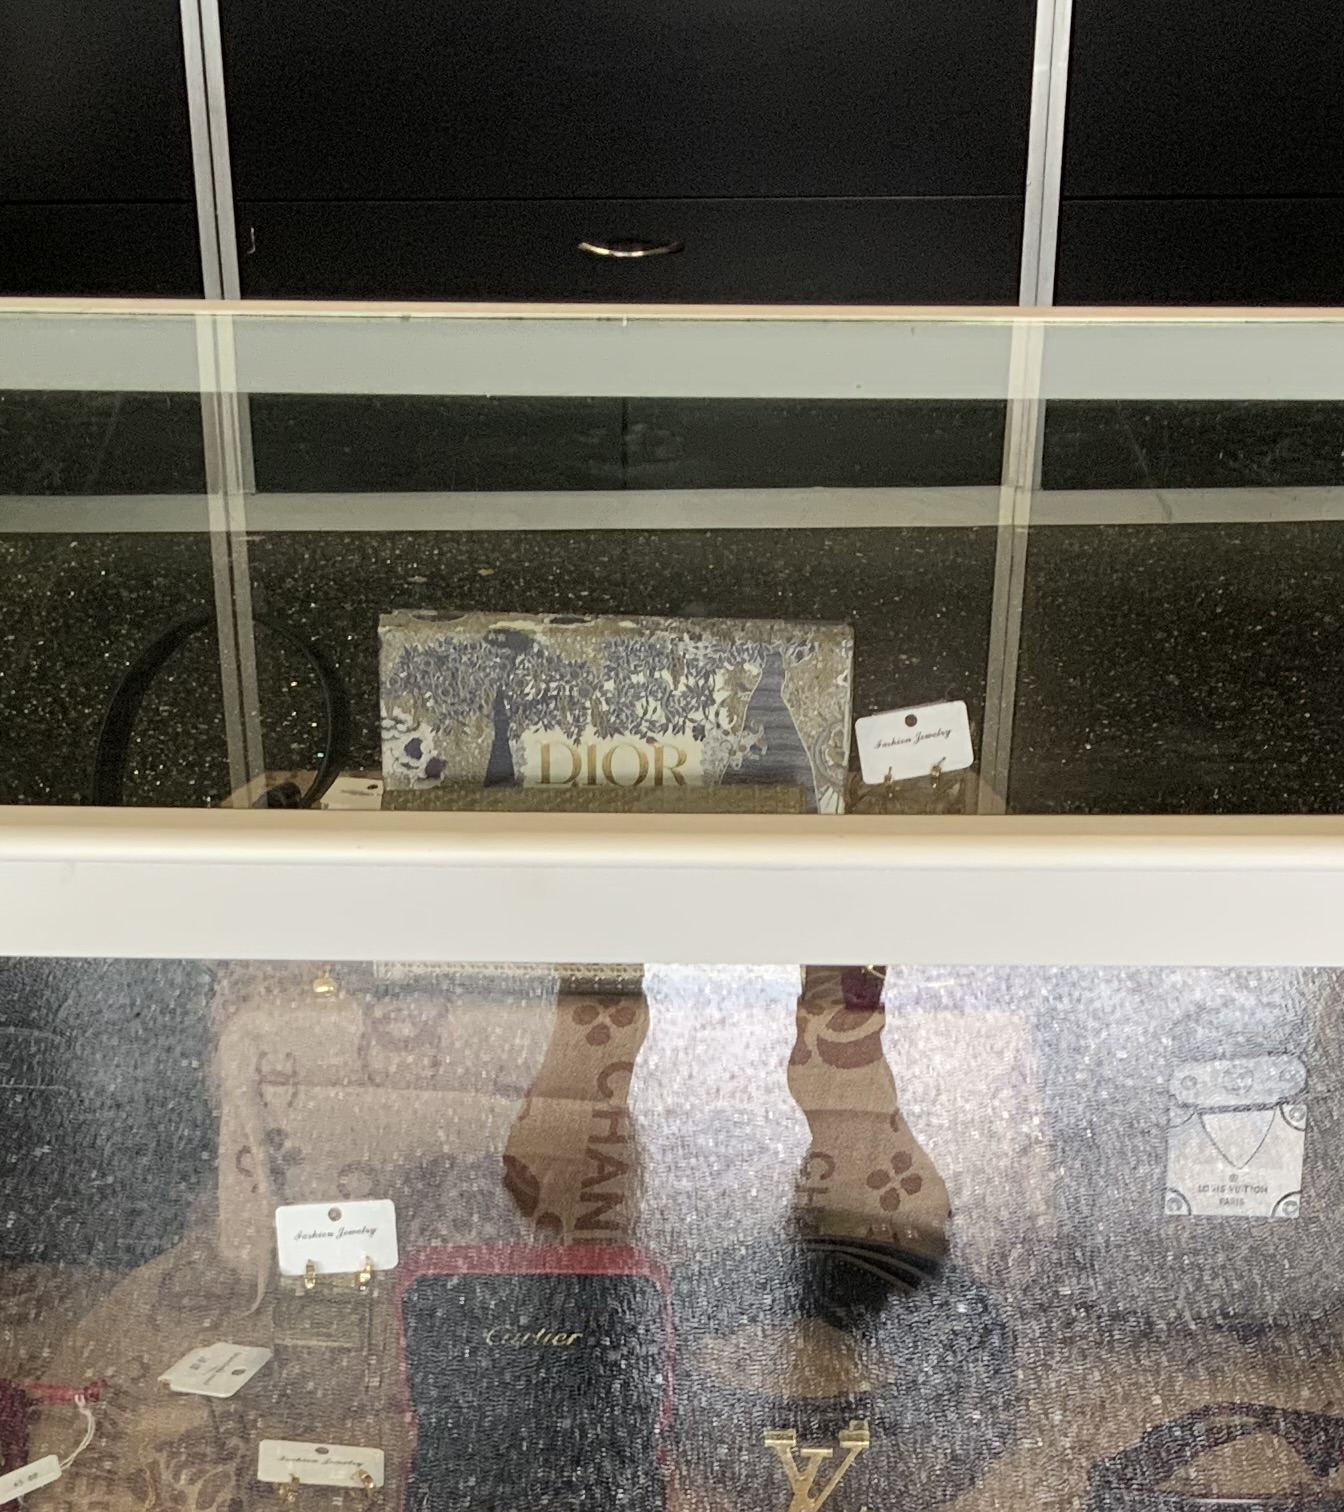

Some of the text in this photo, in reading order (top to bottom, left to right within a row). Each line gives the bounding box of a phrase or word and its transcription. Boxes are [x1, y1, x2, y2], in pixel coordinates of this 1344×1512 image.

[873, 727, 953, 749] Fashion Jewelry
[535, 740, 688, 787] DIOR
[293, 1225, 378, 1241] Fashion Jewelry
